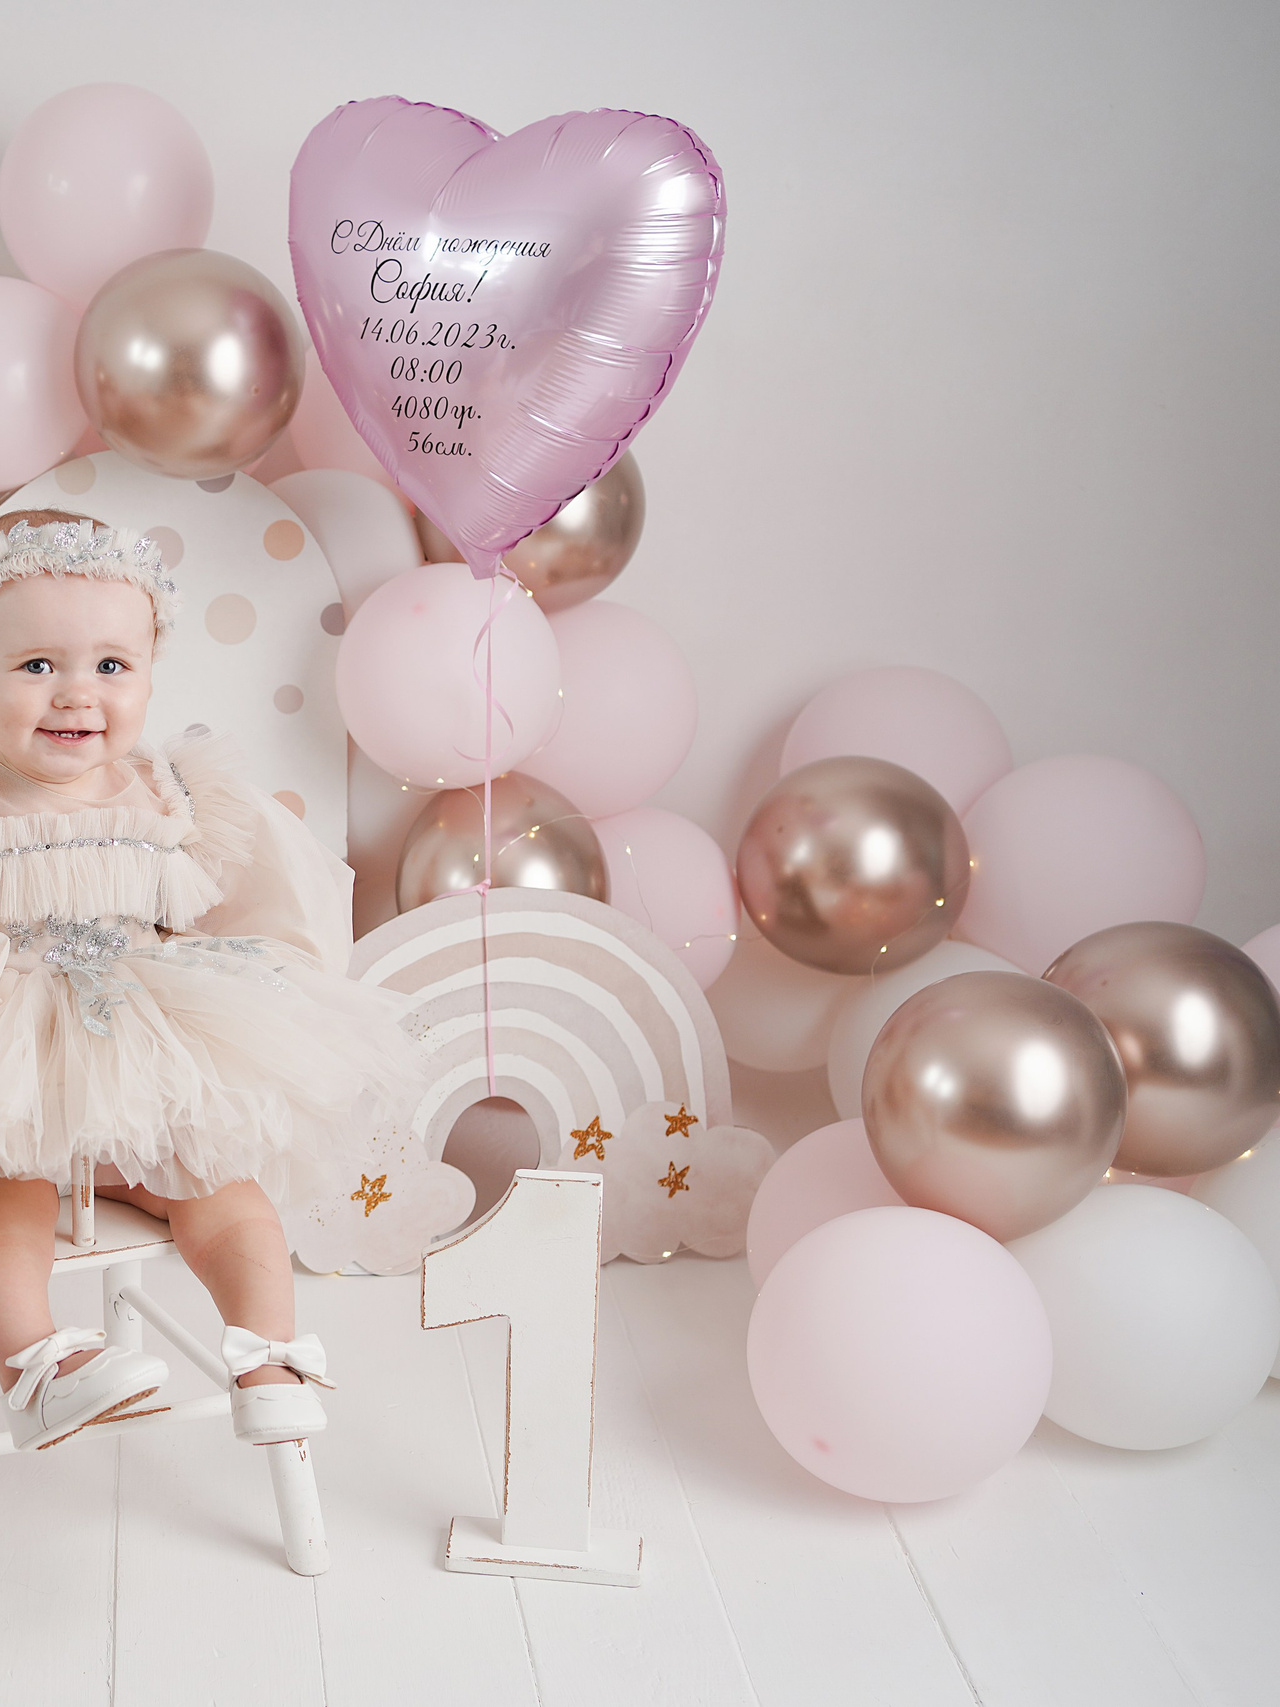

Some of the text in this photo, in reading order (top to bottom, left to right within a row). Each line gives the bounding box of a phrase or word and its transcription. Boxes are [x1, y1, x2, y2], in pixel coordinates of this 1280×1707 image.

[353, 220, 421, 252] Днём
[429, 237, 552, 267] рождения
[371, 257, 488, 313] София!
[360, 317, 516, 350] 14.06.2023г.
[390, 356, 463, 384] 08:00
[391, 395, 482, 429] 4080гр.
[407, 432, 472, 457] 56см.
[421, 1169, 603, 1552] 1
